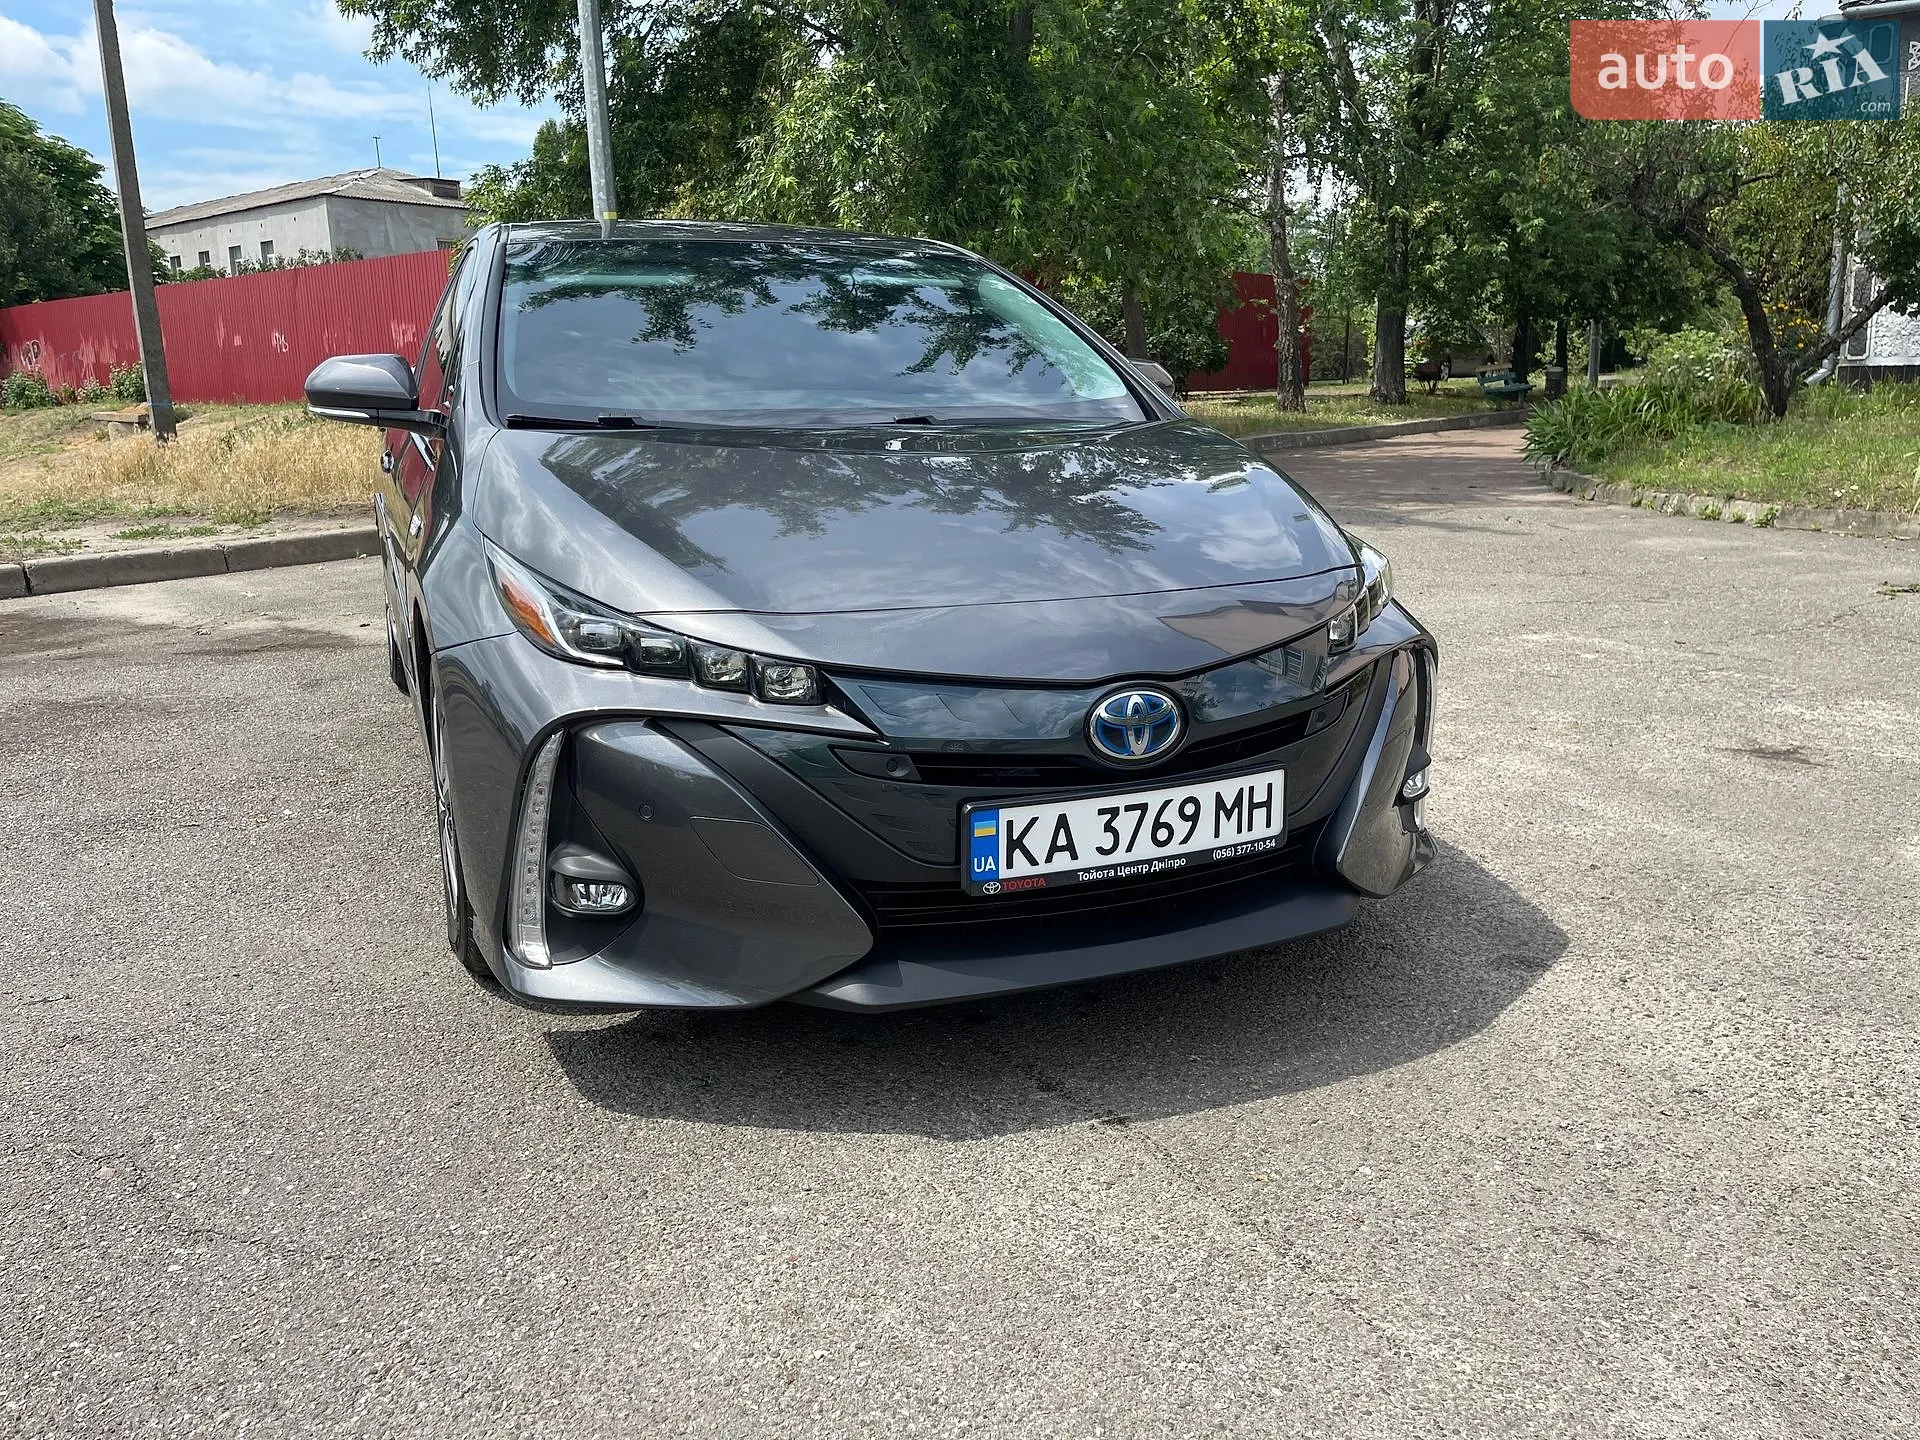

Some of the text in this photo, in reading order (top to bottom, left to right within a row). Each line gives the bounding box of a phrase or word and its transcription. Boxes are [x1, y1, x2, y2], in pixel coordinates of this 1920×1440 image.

[1005, 782, 1274, 870] KA 3769 MH
[1212, 838, 1276, 860] (056) 377-10-54
[973, 856, 996, 873] UA
[1077, 857, 1187, 882] Тойота Центр Дніпро
[1002, 878, 1046, 891] TOYOTA
